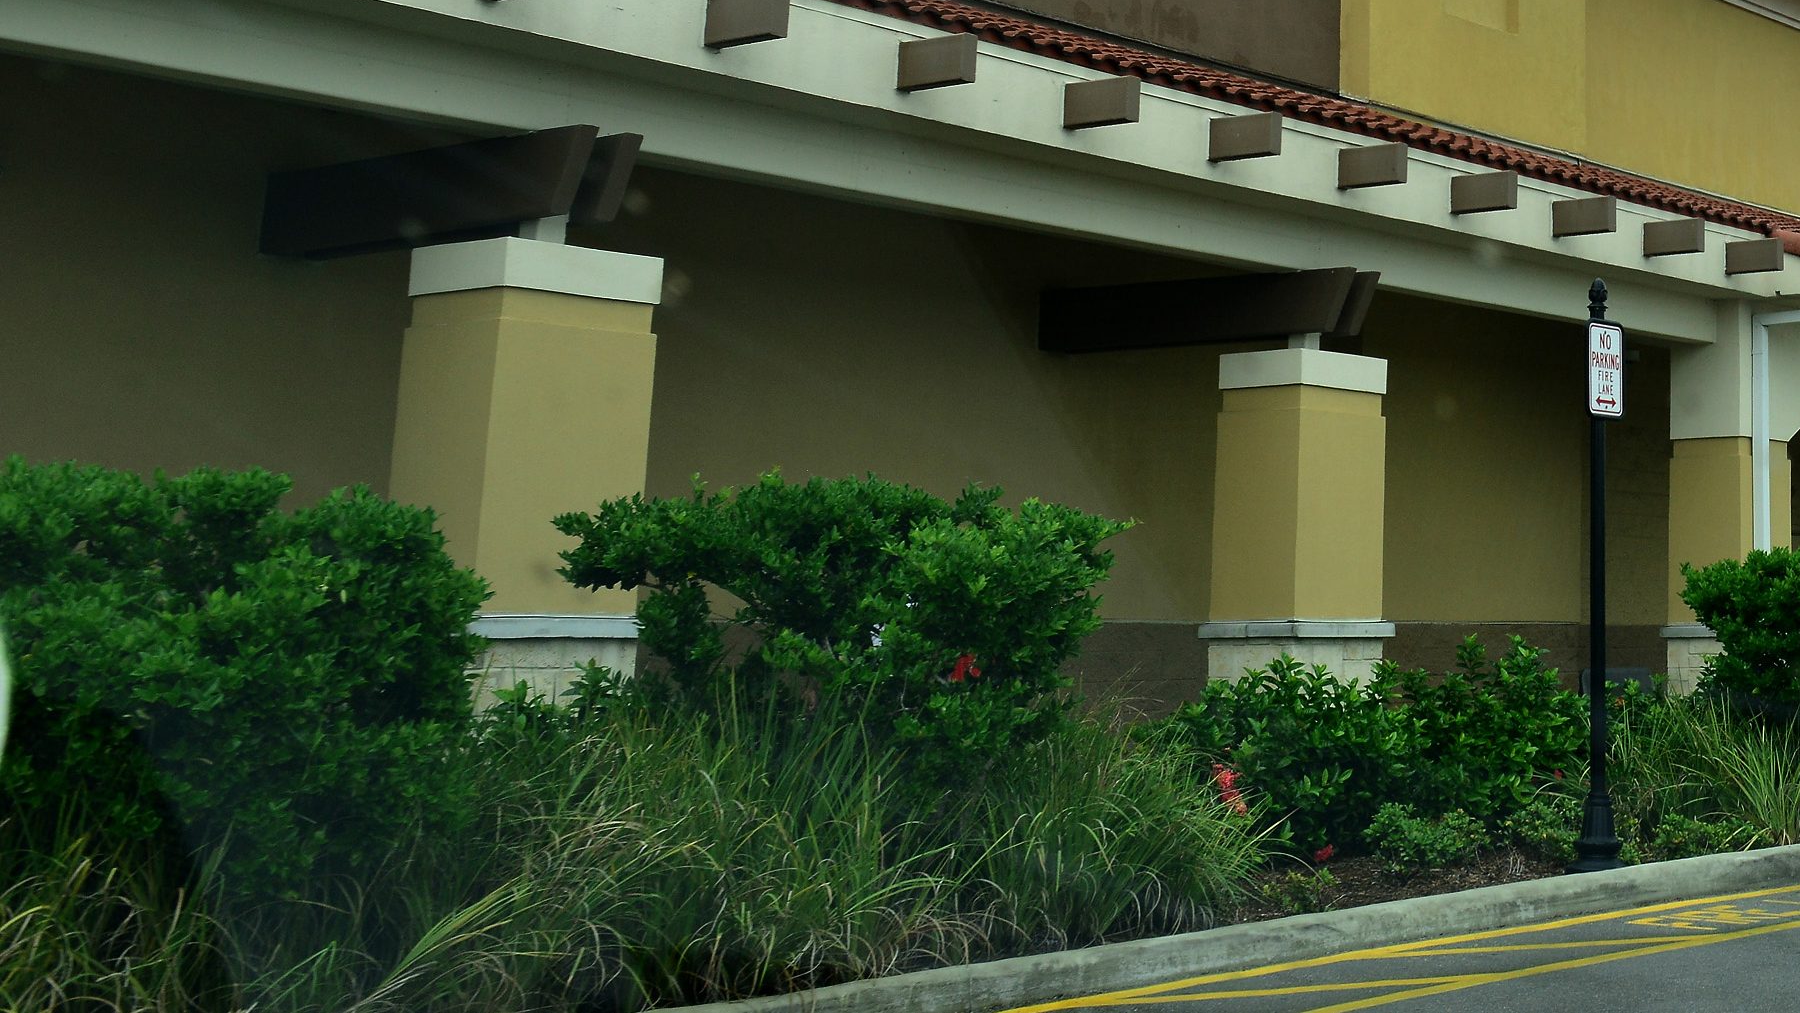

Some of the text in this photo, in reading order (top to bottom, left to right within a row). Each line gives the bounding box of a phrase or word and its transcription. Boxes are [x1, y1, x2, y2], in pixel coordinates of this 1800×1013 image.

[1599, 333, 1612, 350] NO
[1591, 351, 1620, 371] PARKING
[1597, 370, 1614, 383] FIRE
[1598, 383, 1614, 396] LANE
